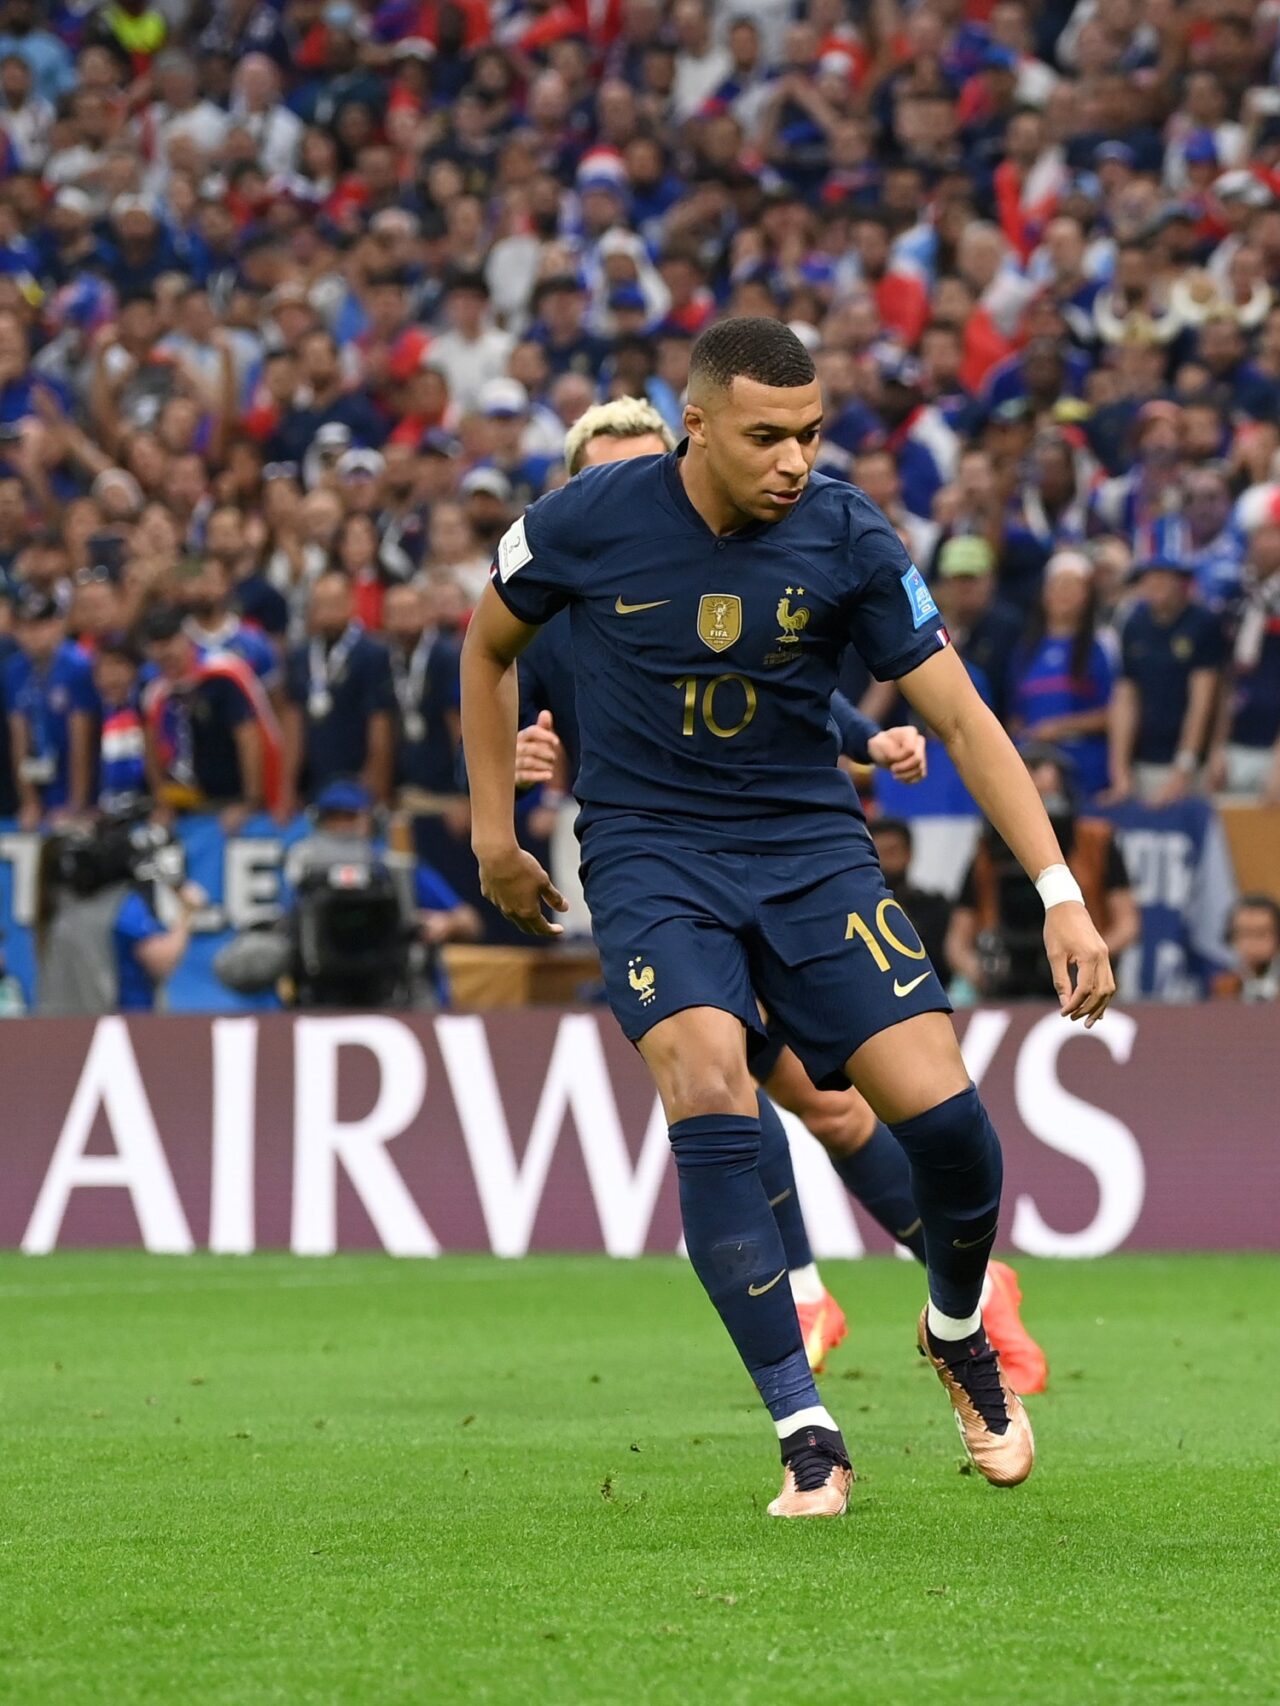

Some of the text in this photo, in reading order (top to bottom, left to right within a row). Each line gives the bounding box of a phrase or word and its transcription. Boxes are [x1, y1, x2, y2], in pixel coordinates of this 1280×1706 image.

[710, 629, 729, 638] FIFA
[672, 672, 758, 739] 10
[844, 898, 927, 973] 10
[19, 1007, 1147, 1261] AIRWS
